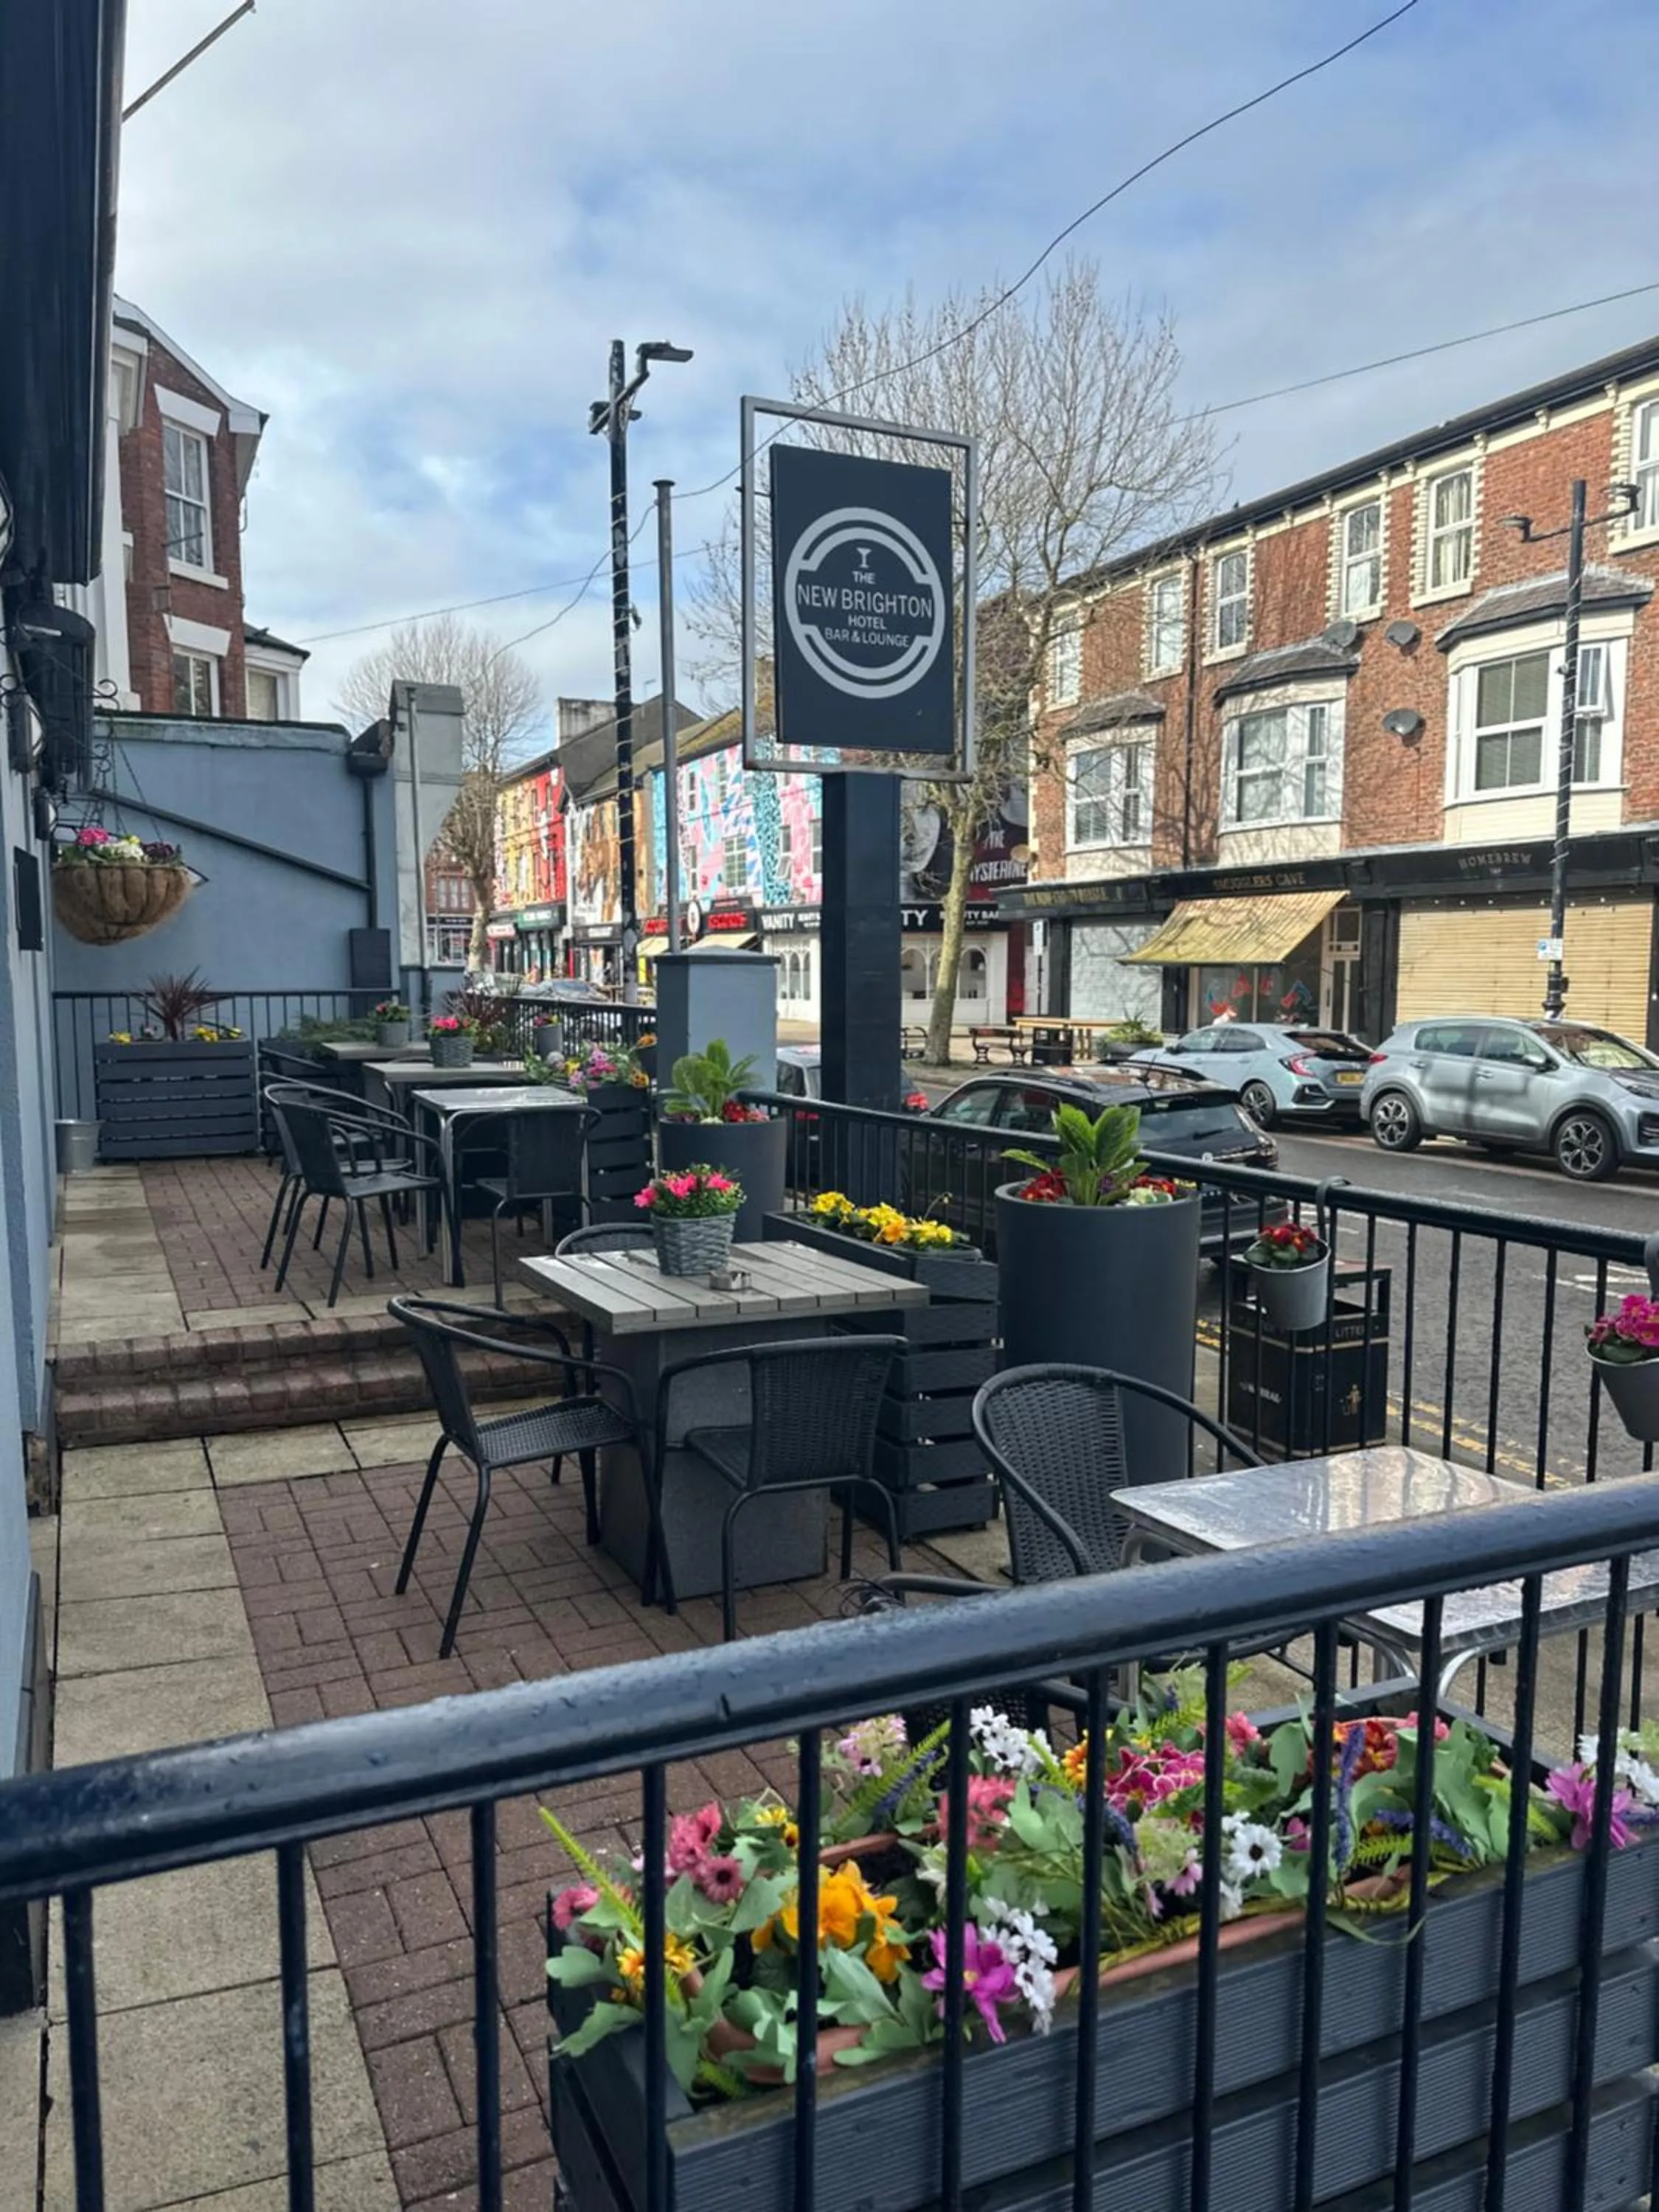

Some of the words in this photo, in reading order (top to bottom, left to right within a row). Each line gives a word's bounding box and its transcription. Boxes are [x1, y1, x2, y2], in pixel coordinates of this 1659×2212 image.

[852, 571, 876, 585] THE
[797, 584, 839, 608] NEW
[841, 588, 933, 619] BRIGHTON
[848, 614, 887, 630] HOTEL
[824, 627, 850, 643] BAR
[862, 632, 910, 648] LOUNGE
[1458, 852, 1532, 871] HOMEBREW
[970, 859, 1027, 883] YSTERINE
[1276, 872, 1306, 886] CAVE
[761, 913, 795, 930] VANITY
